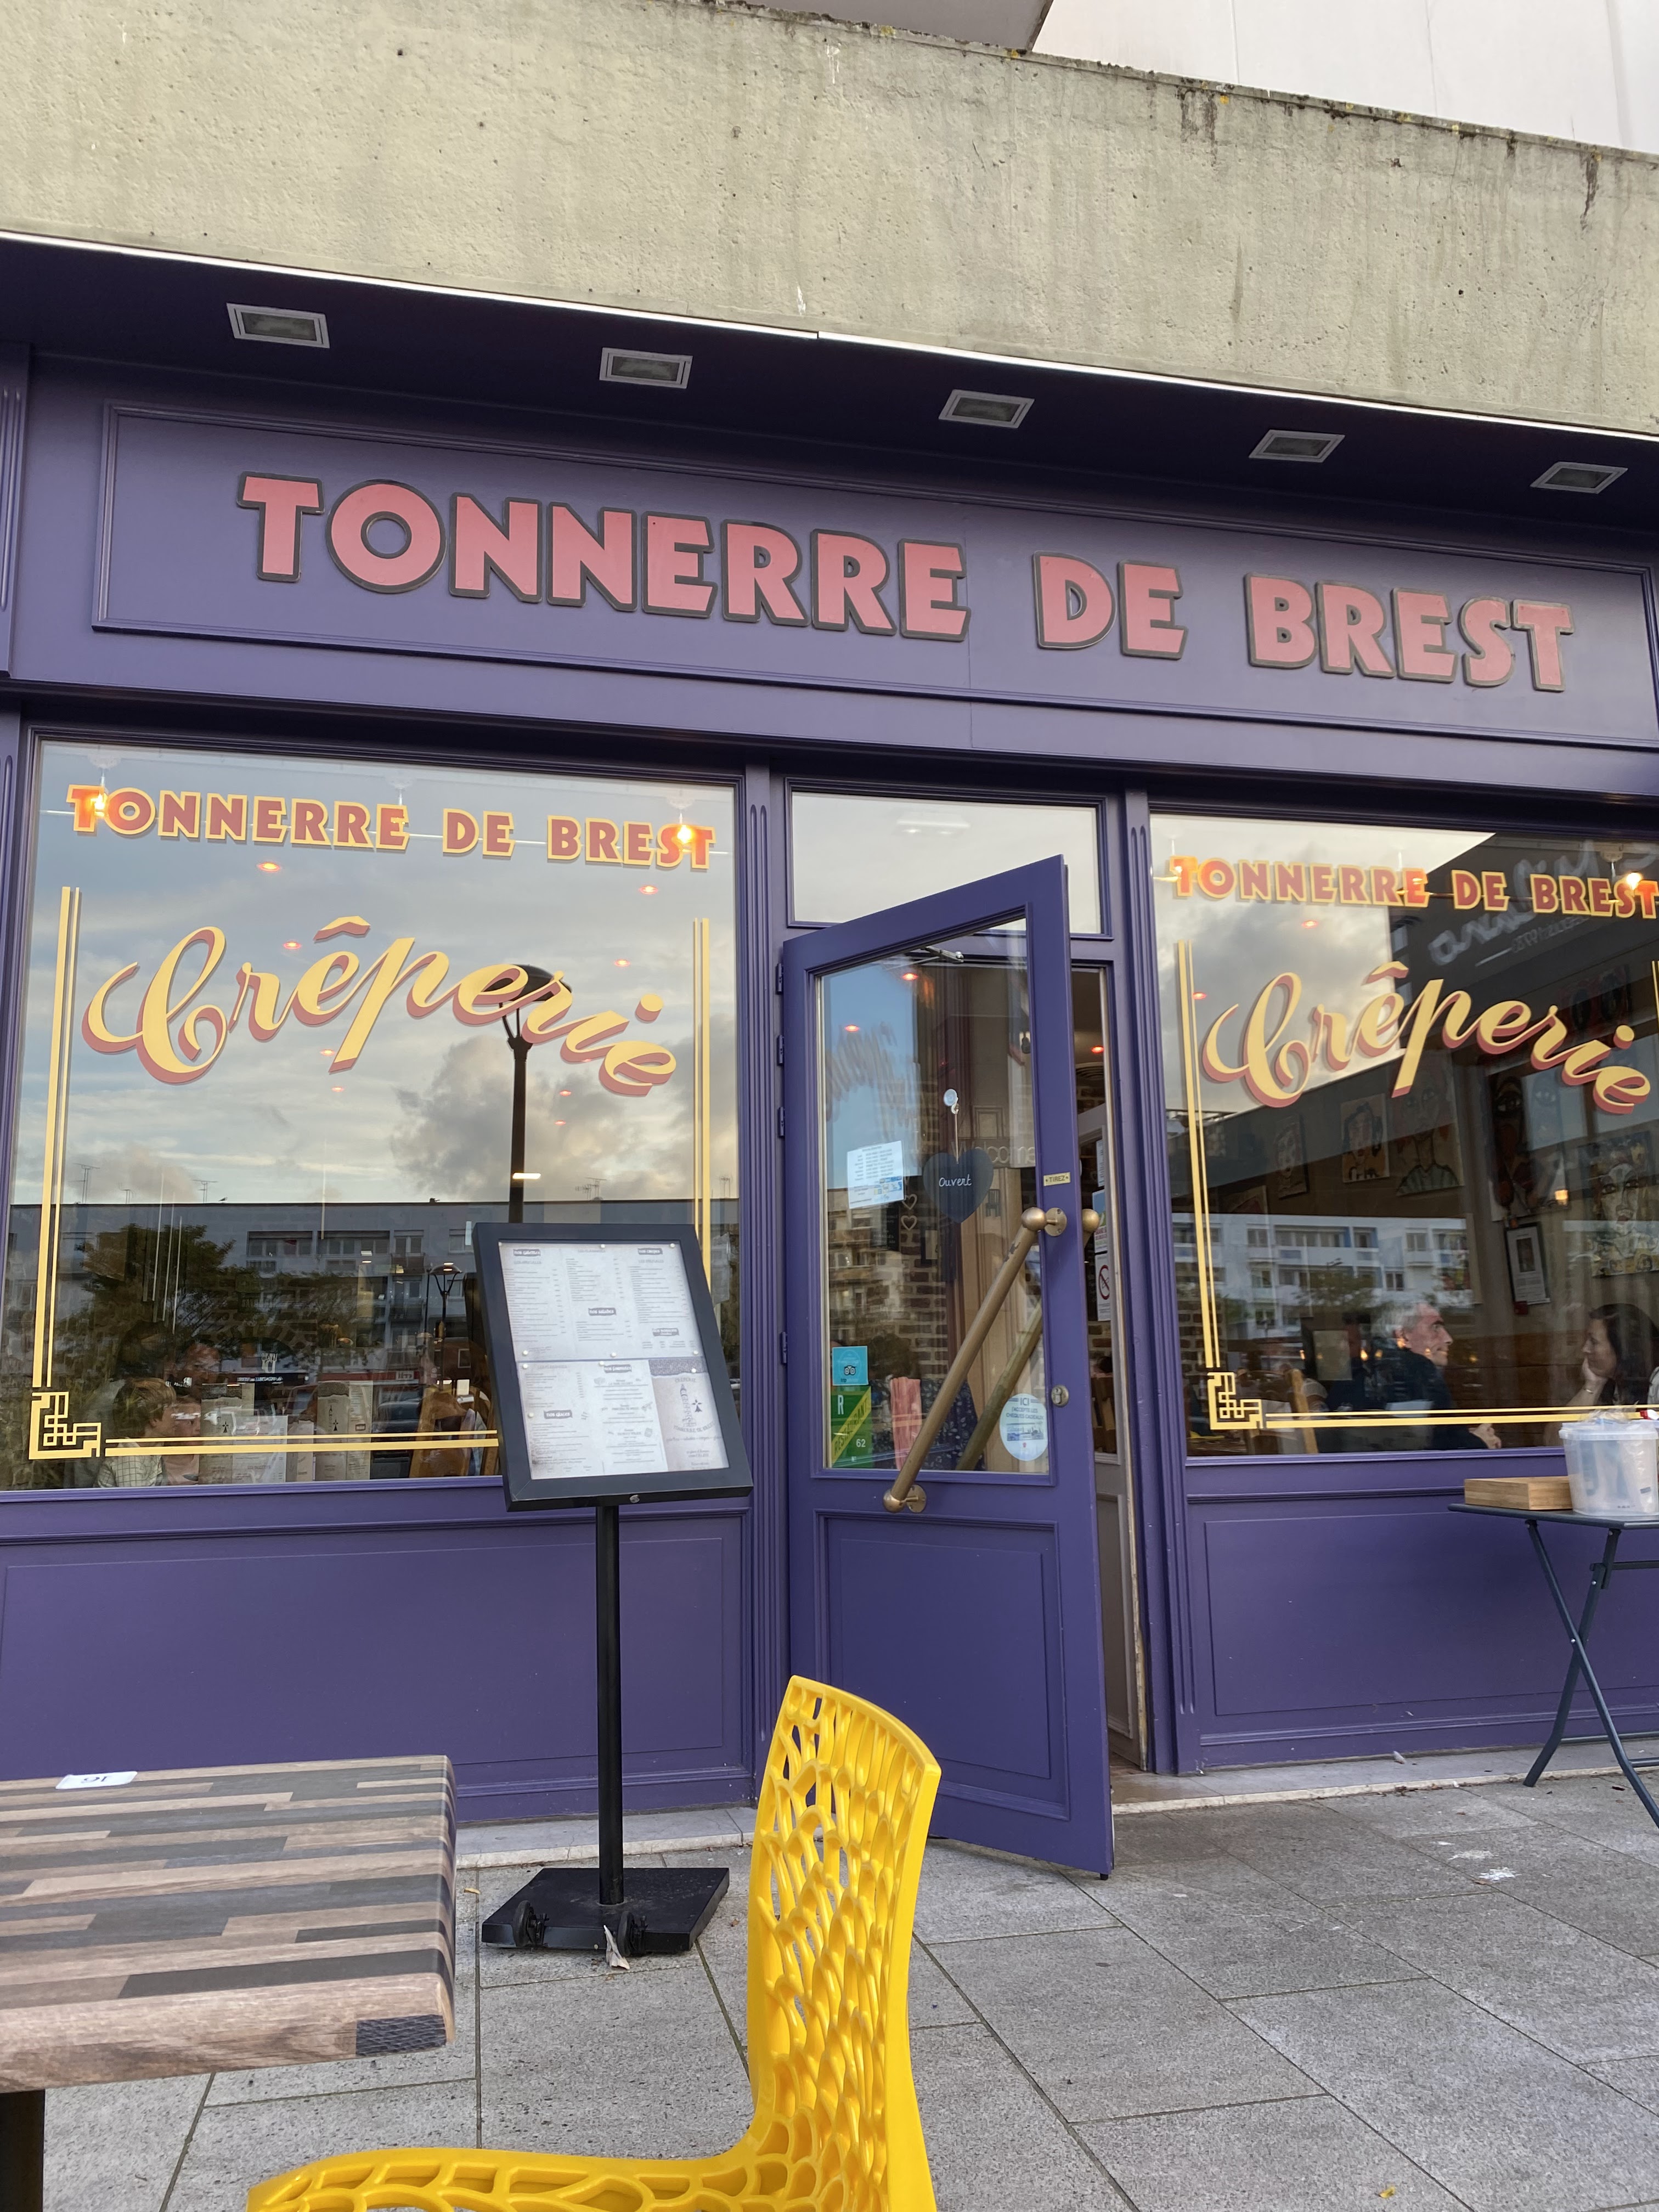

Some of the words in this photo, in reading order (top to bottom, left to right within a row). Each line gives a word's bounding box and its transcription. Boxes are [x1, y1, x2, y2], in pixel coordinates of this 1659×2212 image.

[236, 471, 970, 642] TONNERRE
[1032, 550, 1188, 660] DE
[1243, 572, 1575, 692] BREST
[66, 785, 410, 850] TONNERRE
[442, 808, 516, 857] DE
[548, 815, 716, 870] BREST
[1170, 855, 1430, 907] TONNERRE
[1451, 870, 1510, 911] DE
[1530, 873, 1659, 919] BREST
[82, 915, 676, 1097] Crêperie
[1203, 961, 1650, 1114] Crêperie
[939, 1173, 972, 1187] Ouvert
[833, 1398, 868, 1455] RESTAURANT
[1020, 1398, 1030, 1406] ICI
[856, 1438, 866, 1448] 62
